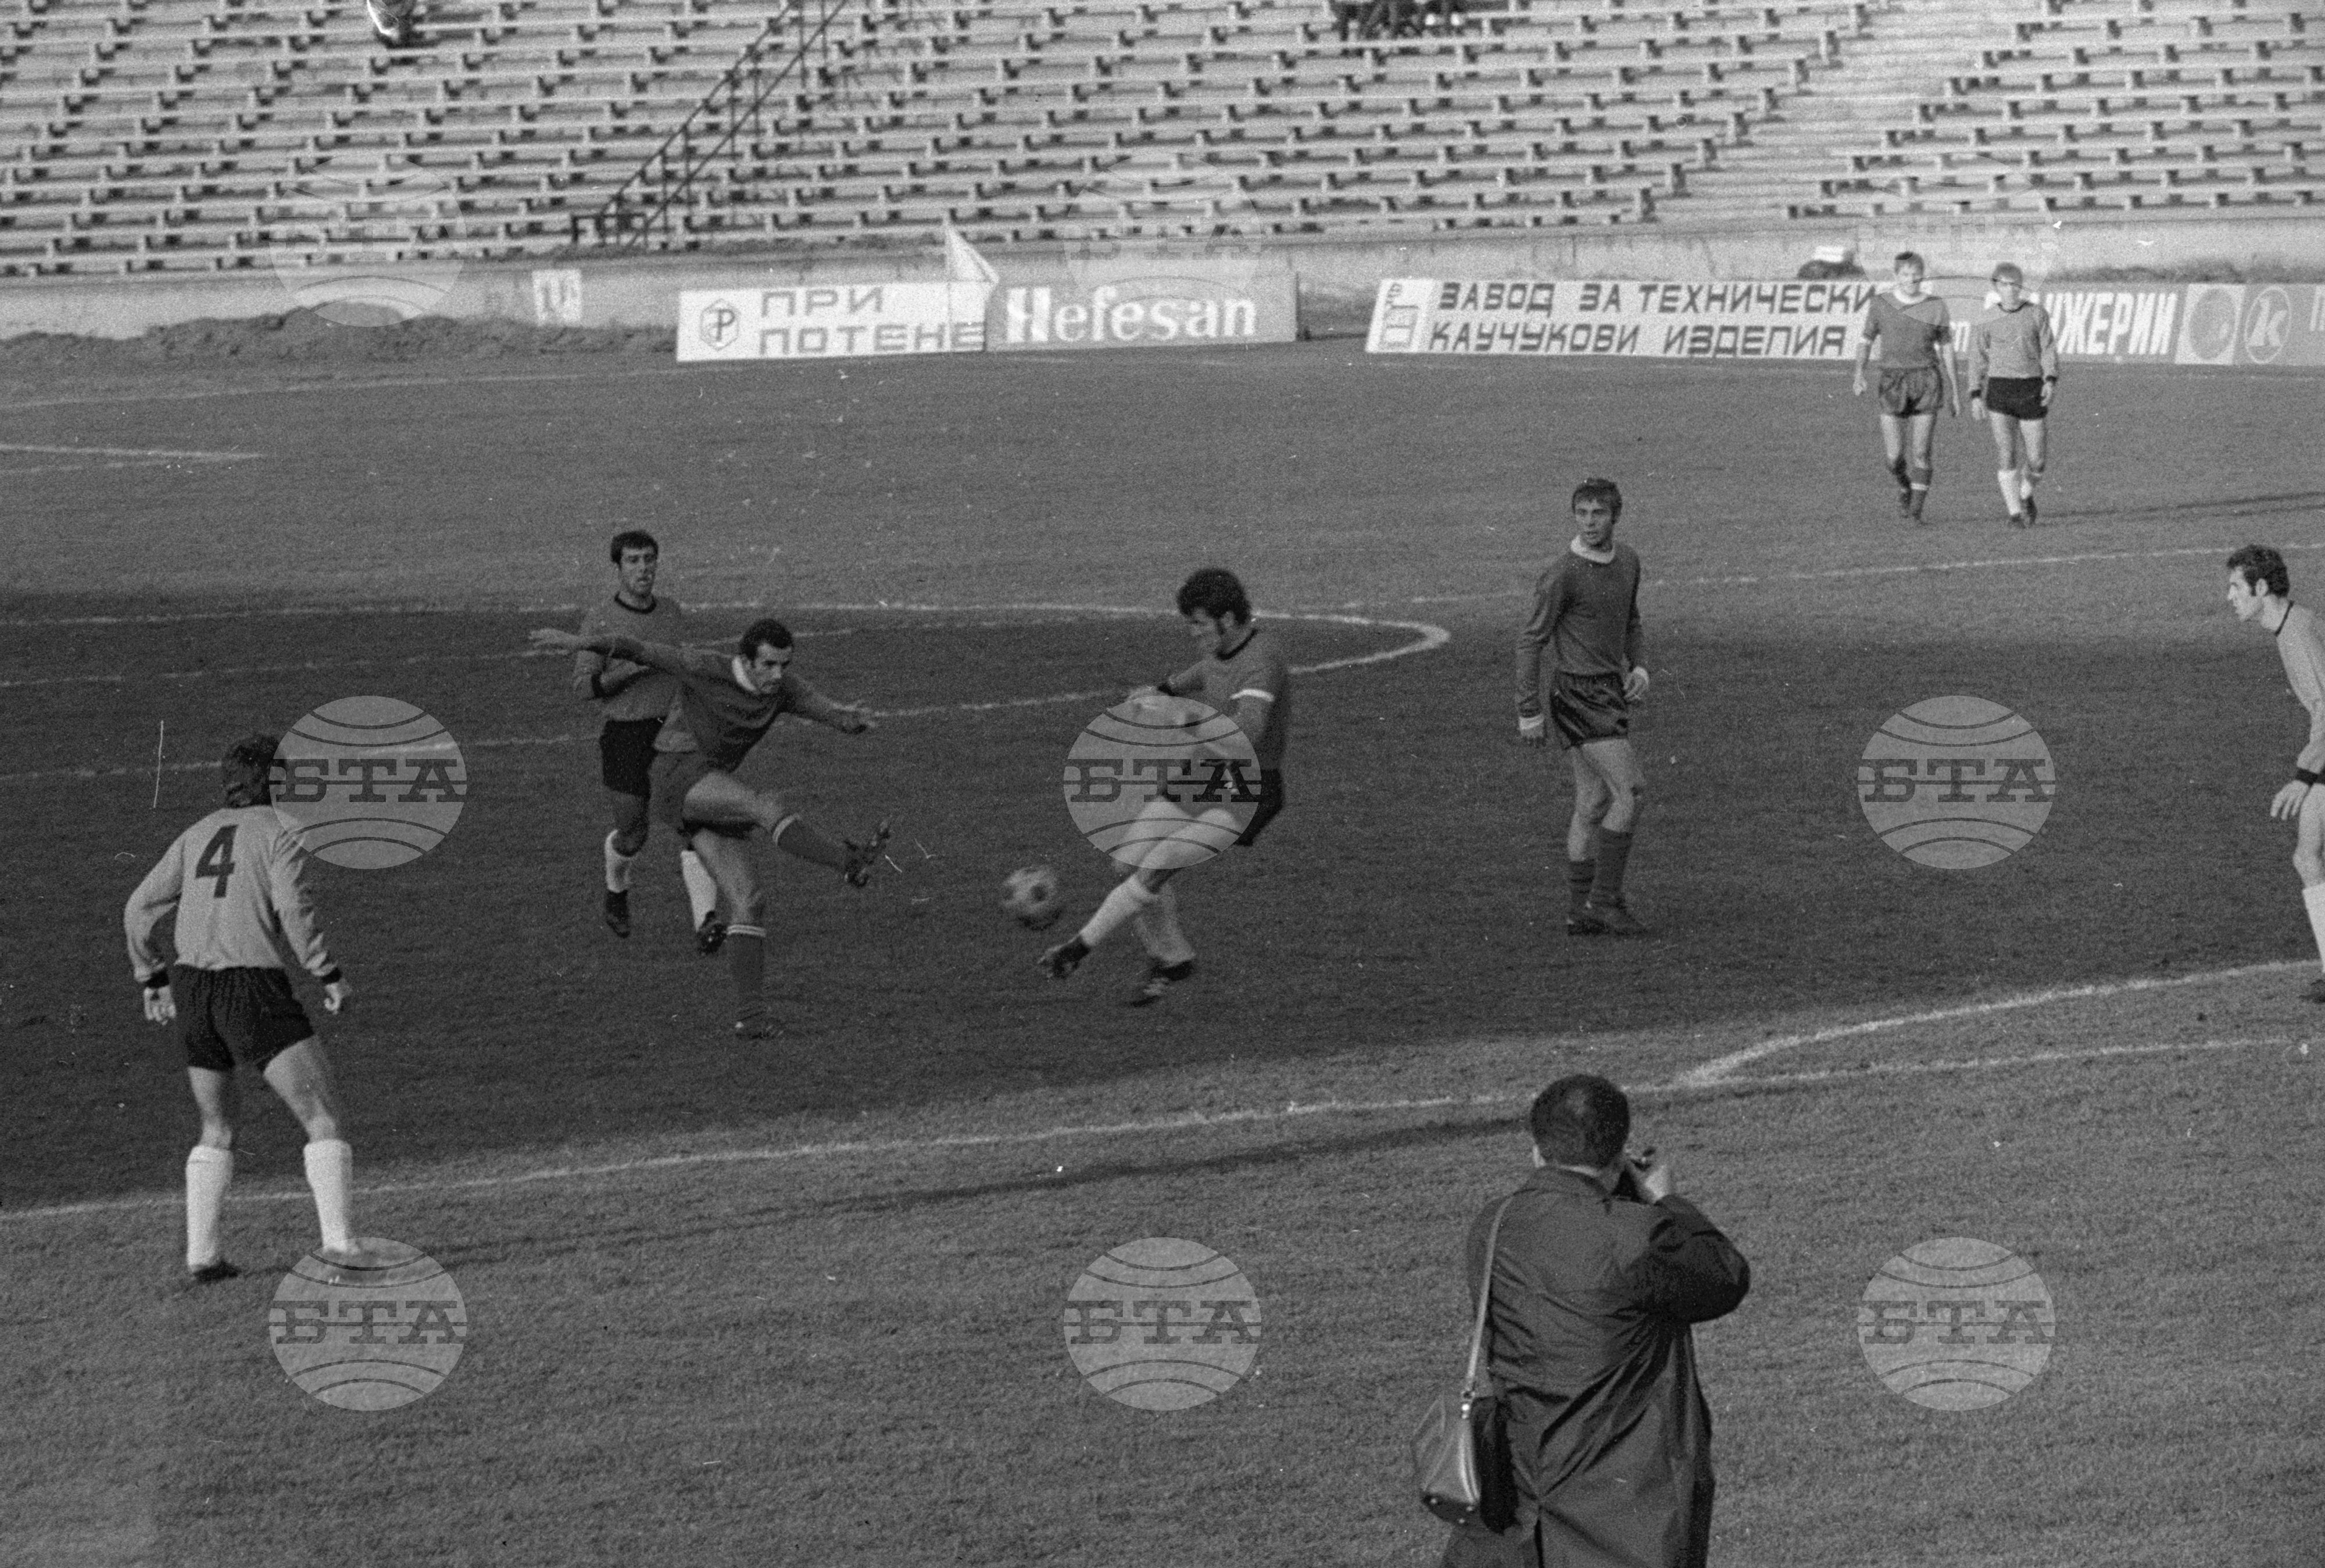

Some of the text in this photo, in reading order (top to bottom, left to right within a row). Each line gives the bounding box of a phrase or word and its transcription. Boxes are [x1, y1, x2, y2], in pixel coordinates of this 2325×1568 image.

[761, 286, 883, 318] ПРИ
[1007, 286, 1257, 343] Hefesan
[1439, 282, 1876, 318] ЗАВОД ЗА ТЕХНИЧЕСКИ
[759, 321, 986, 355] ПОТЕНЕ
[1429, 323, 1640, 353] КАУЧУКОВИ
[195, 824, 239, 898] 4
